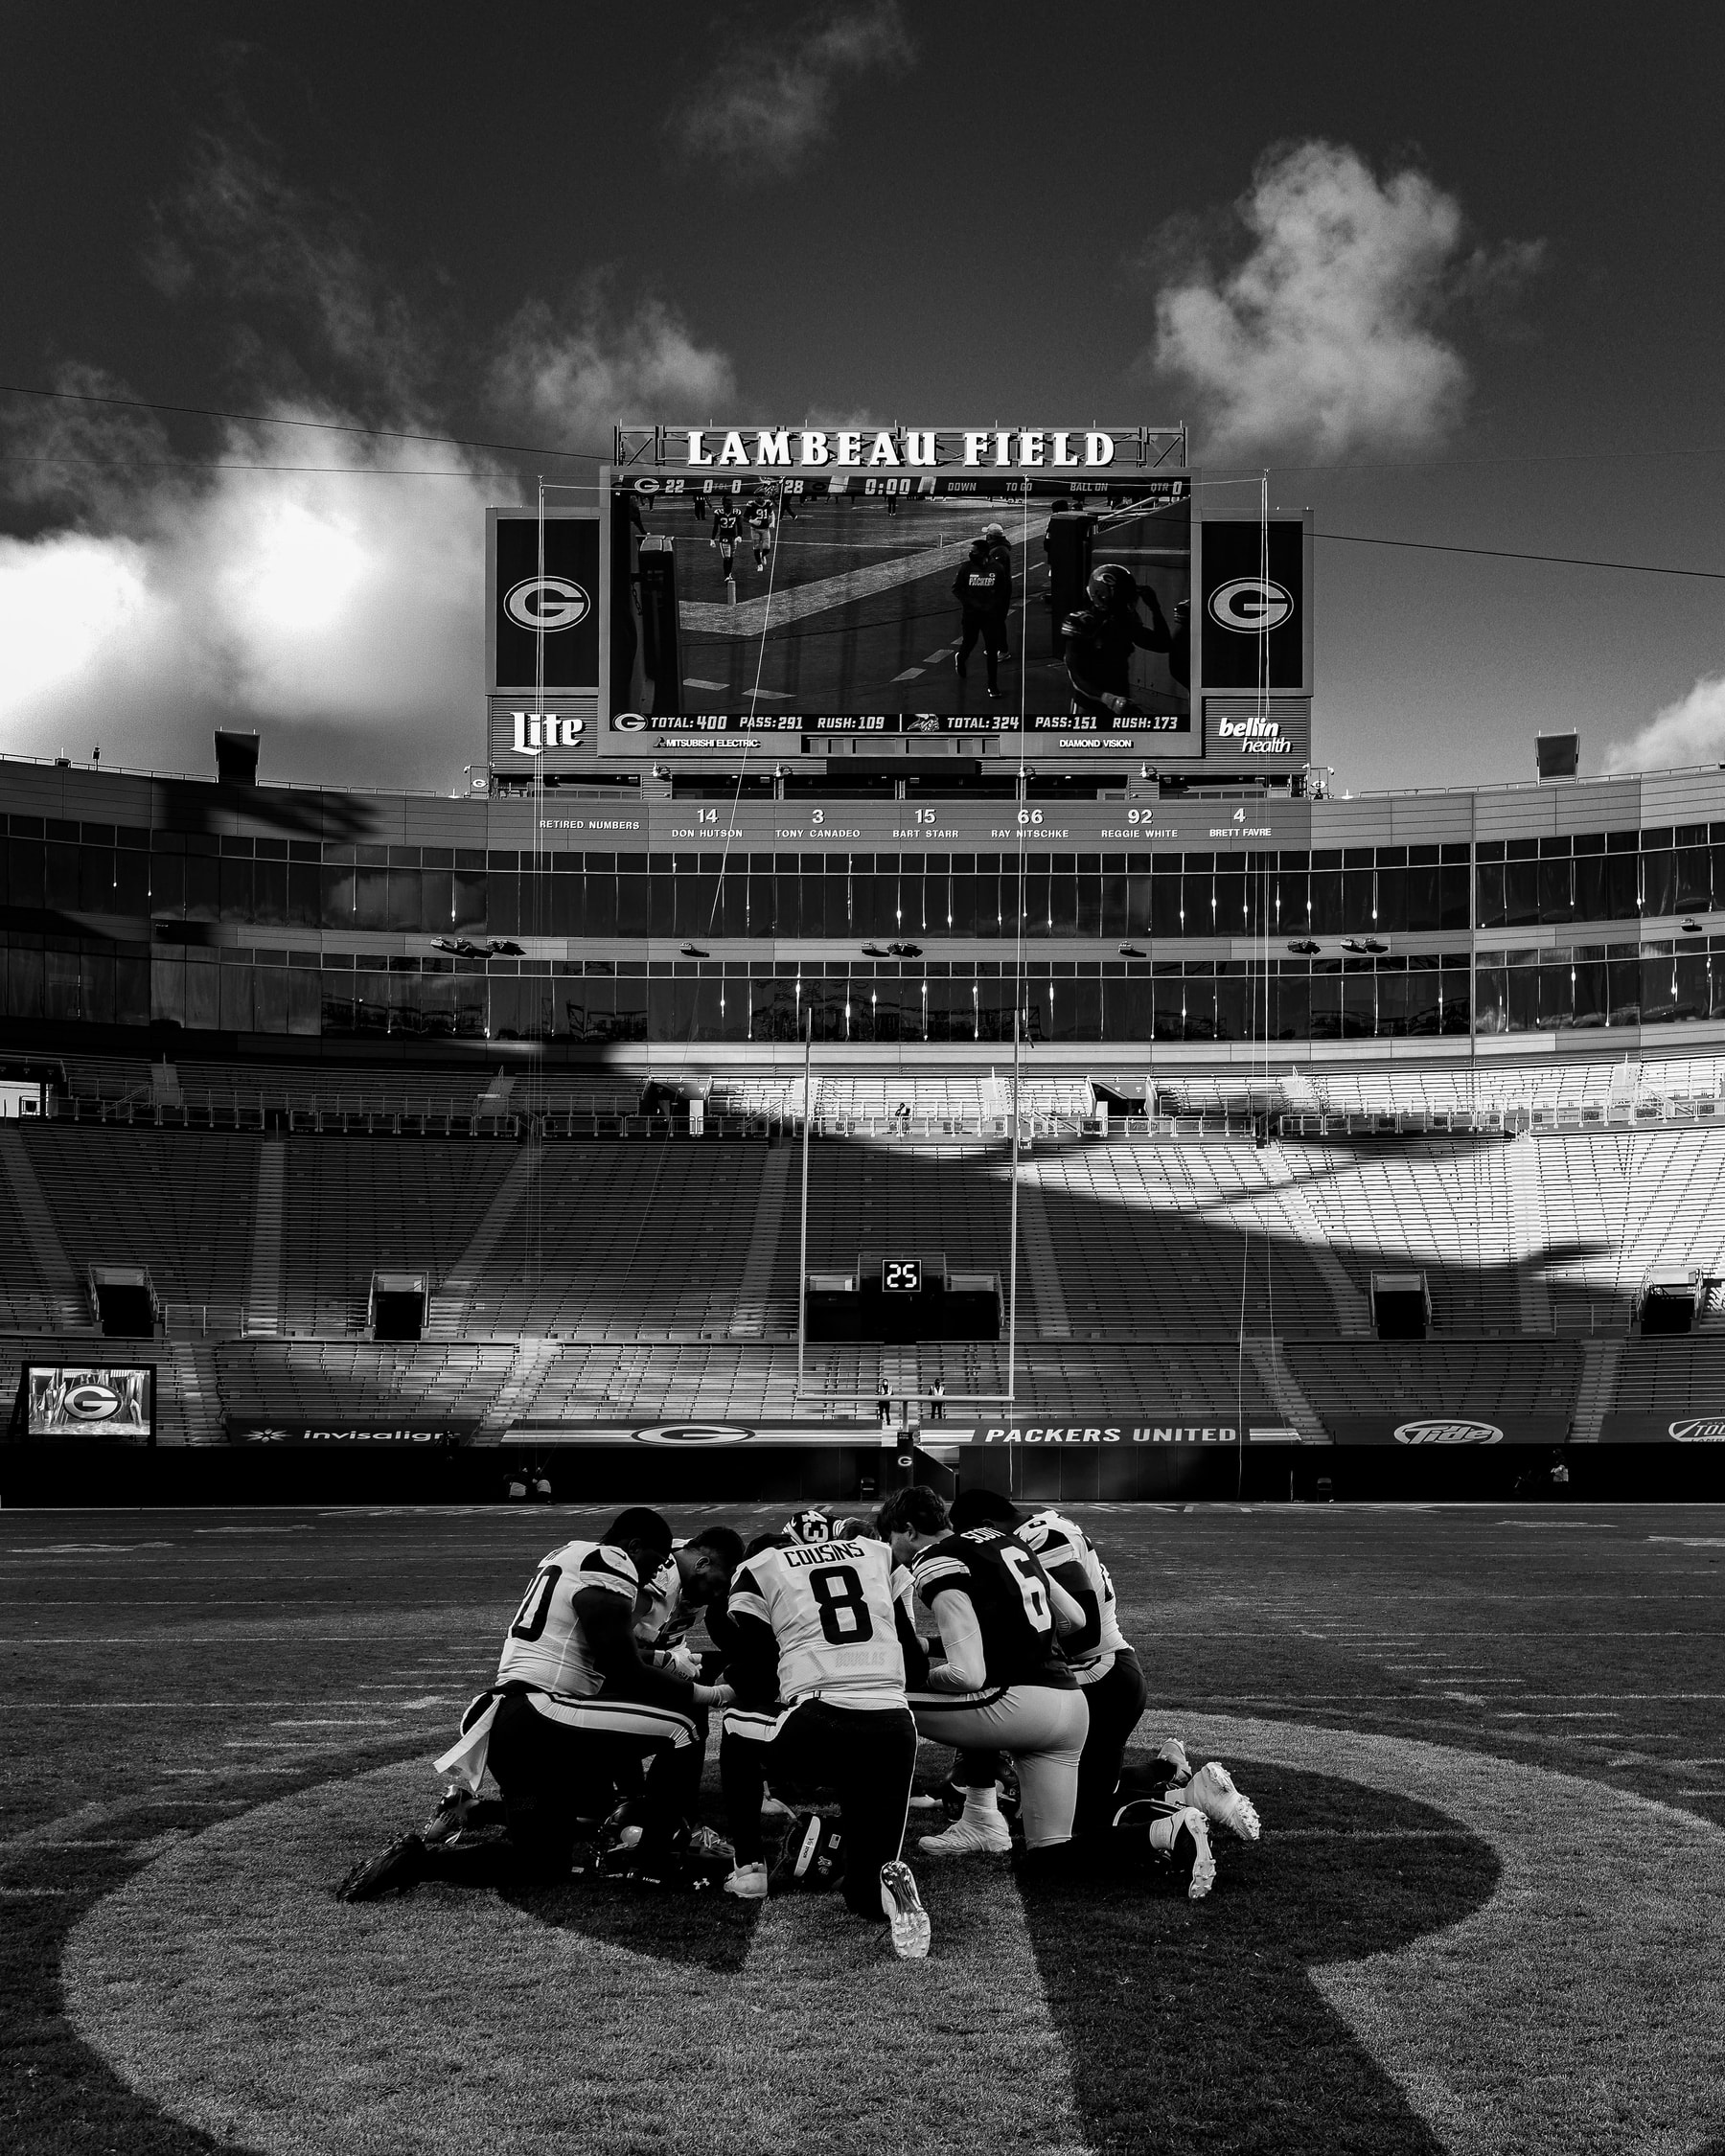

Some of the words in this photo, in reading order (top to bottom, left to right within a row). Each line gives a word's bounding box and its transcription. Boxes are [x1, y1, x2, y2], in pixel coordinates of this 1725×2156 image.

[687, 431, 937, 467] LAMBEAU
[963, 431, 1116, 467] FIELD
[665, 479, 685, 493] 22
[784, 479, 804, 493] 28
[864, 478, 911, 494] 0:00
[947, 482, 977, 492] DOWN
[1006, 482, 1018, 492] TO
[1020, 482, 1033, 492] GO
[1070, 482, 1092, 492] BALL
[1094, 482, 1109, 492] ON
[1150, 482, 1169, 493] QTR
[1173, 480, 1183, 494] 0
[756, 508, 768, 519] 91
[720, 516, 736, 528] 37
[510, 712, 584, 756] Lite
[1218, 717, 1279, 737] bellin
[666, 739, 715, 748] MITSUBISHI
[716, 739, 760, 748] ELECTRIC
[1059, 739, 1101, 748] DIAMOND
[1102, 739, 1133, 748] VISION
[1241, 737, 1292, 753] health
[697, 808, 719, 824] 14
[812, 809, 825, 824] 3
[914, 809, 936, 824] 15
[1017, 809, 1045, 824] 66
[1127, 809, 1153, 825] 92
[1233, 808, 1247, 823] 4
[539, 819, 585, 830] RETIRED
[588, 821, 640, 831] NUMBERS
[1209, 828, 1240, 837] BRETT
[1242, 827, 1273, 837] FAVRE
[671, 829, 695, 838] DON
[700, 829, 743, 838] HUTSON
[775, 829, 804, 838] TONY
[810, 829, 861, 838] CANADEO
[892, 829, 920, 838] BART
[926, 829, 959, 838] STARR
[991, 829, 1011, 838] RAY
[1016, 829, 1070, 838] NITSCHKE
[1101, 829, 1140, 838] REGGIE
[1145, 829, 1179, 838] WHITE
[886, 1263, 917, 1289] 25
[984, 1427, 1121, 1443] PACKERS
[1132, 1427, 1237, 1442] UNITED
[1402, 1425, 1496, 1444] Tide
[783, 1541, 865, 1568] COUSINS
[1000, 1545, 1052, 1633] 6
[809, 1565, 874, 1645] 8
